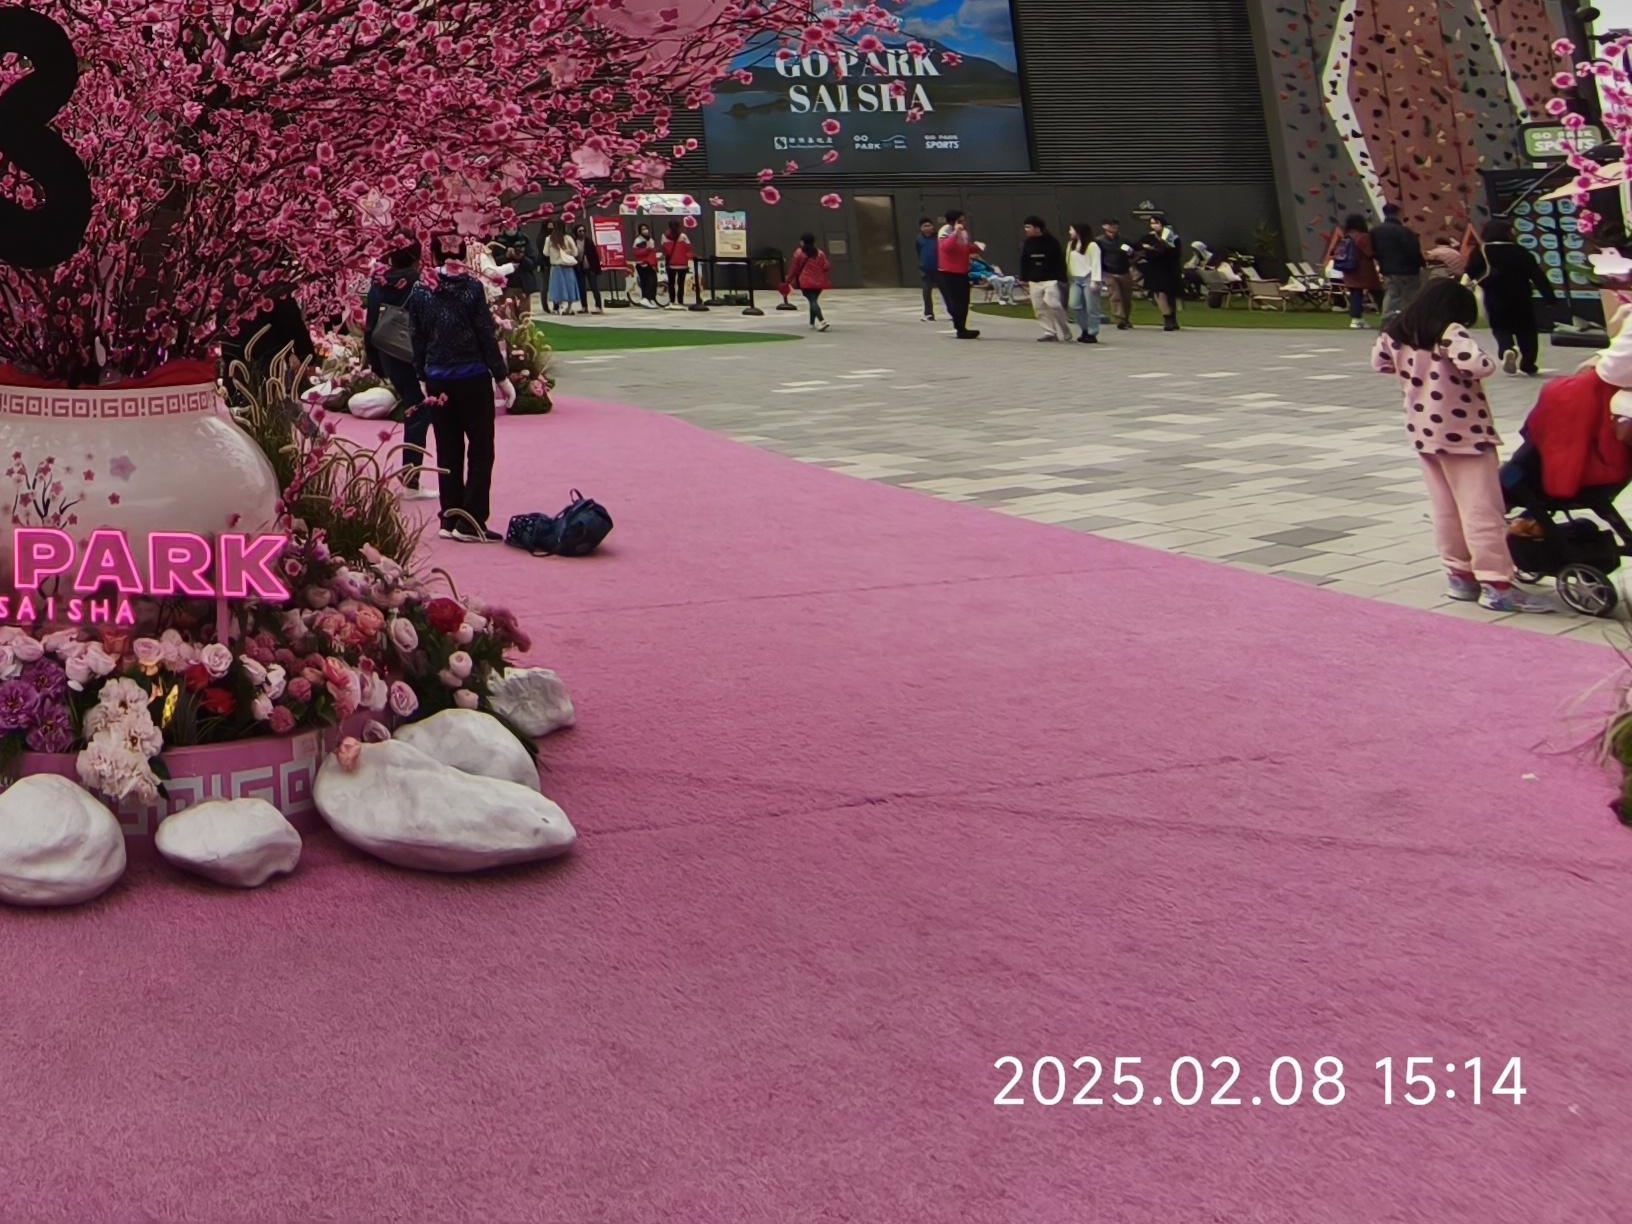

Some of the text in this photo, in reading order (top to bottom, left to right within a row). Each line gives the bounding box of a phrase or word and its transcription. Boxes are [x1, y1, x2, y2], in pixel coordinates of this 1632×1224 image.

[789, 83, 935, 113] SAI SHA
[925, 140, 960, 150] SPORTS
[1534, 138, 1596, 152] SPTS
[14, 527, 290, 600] PARK
